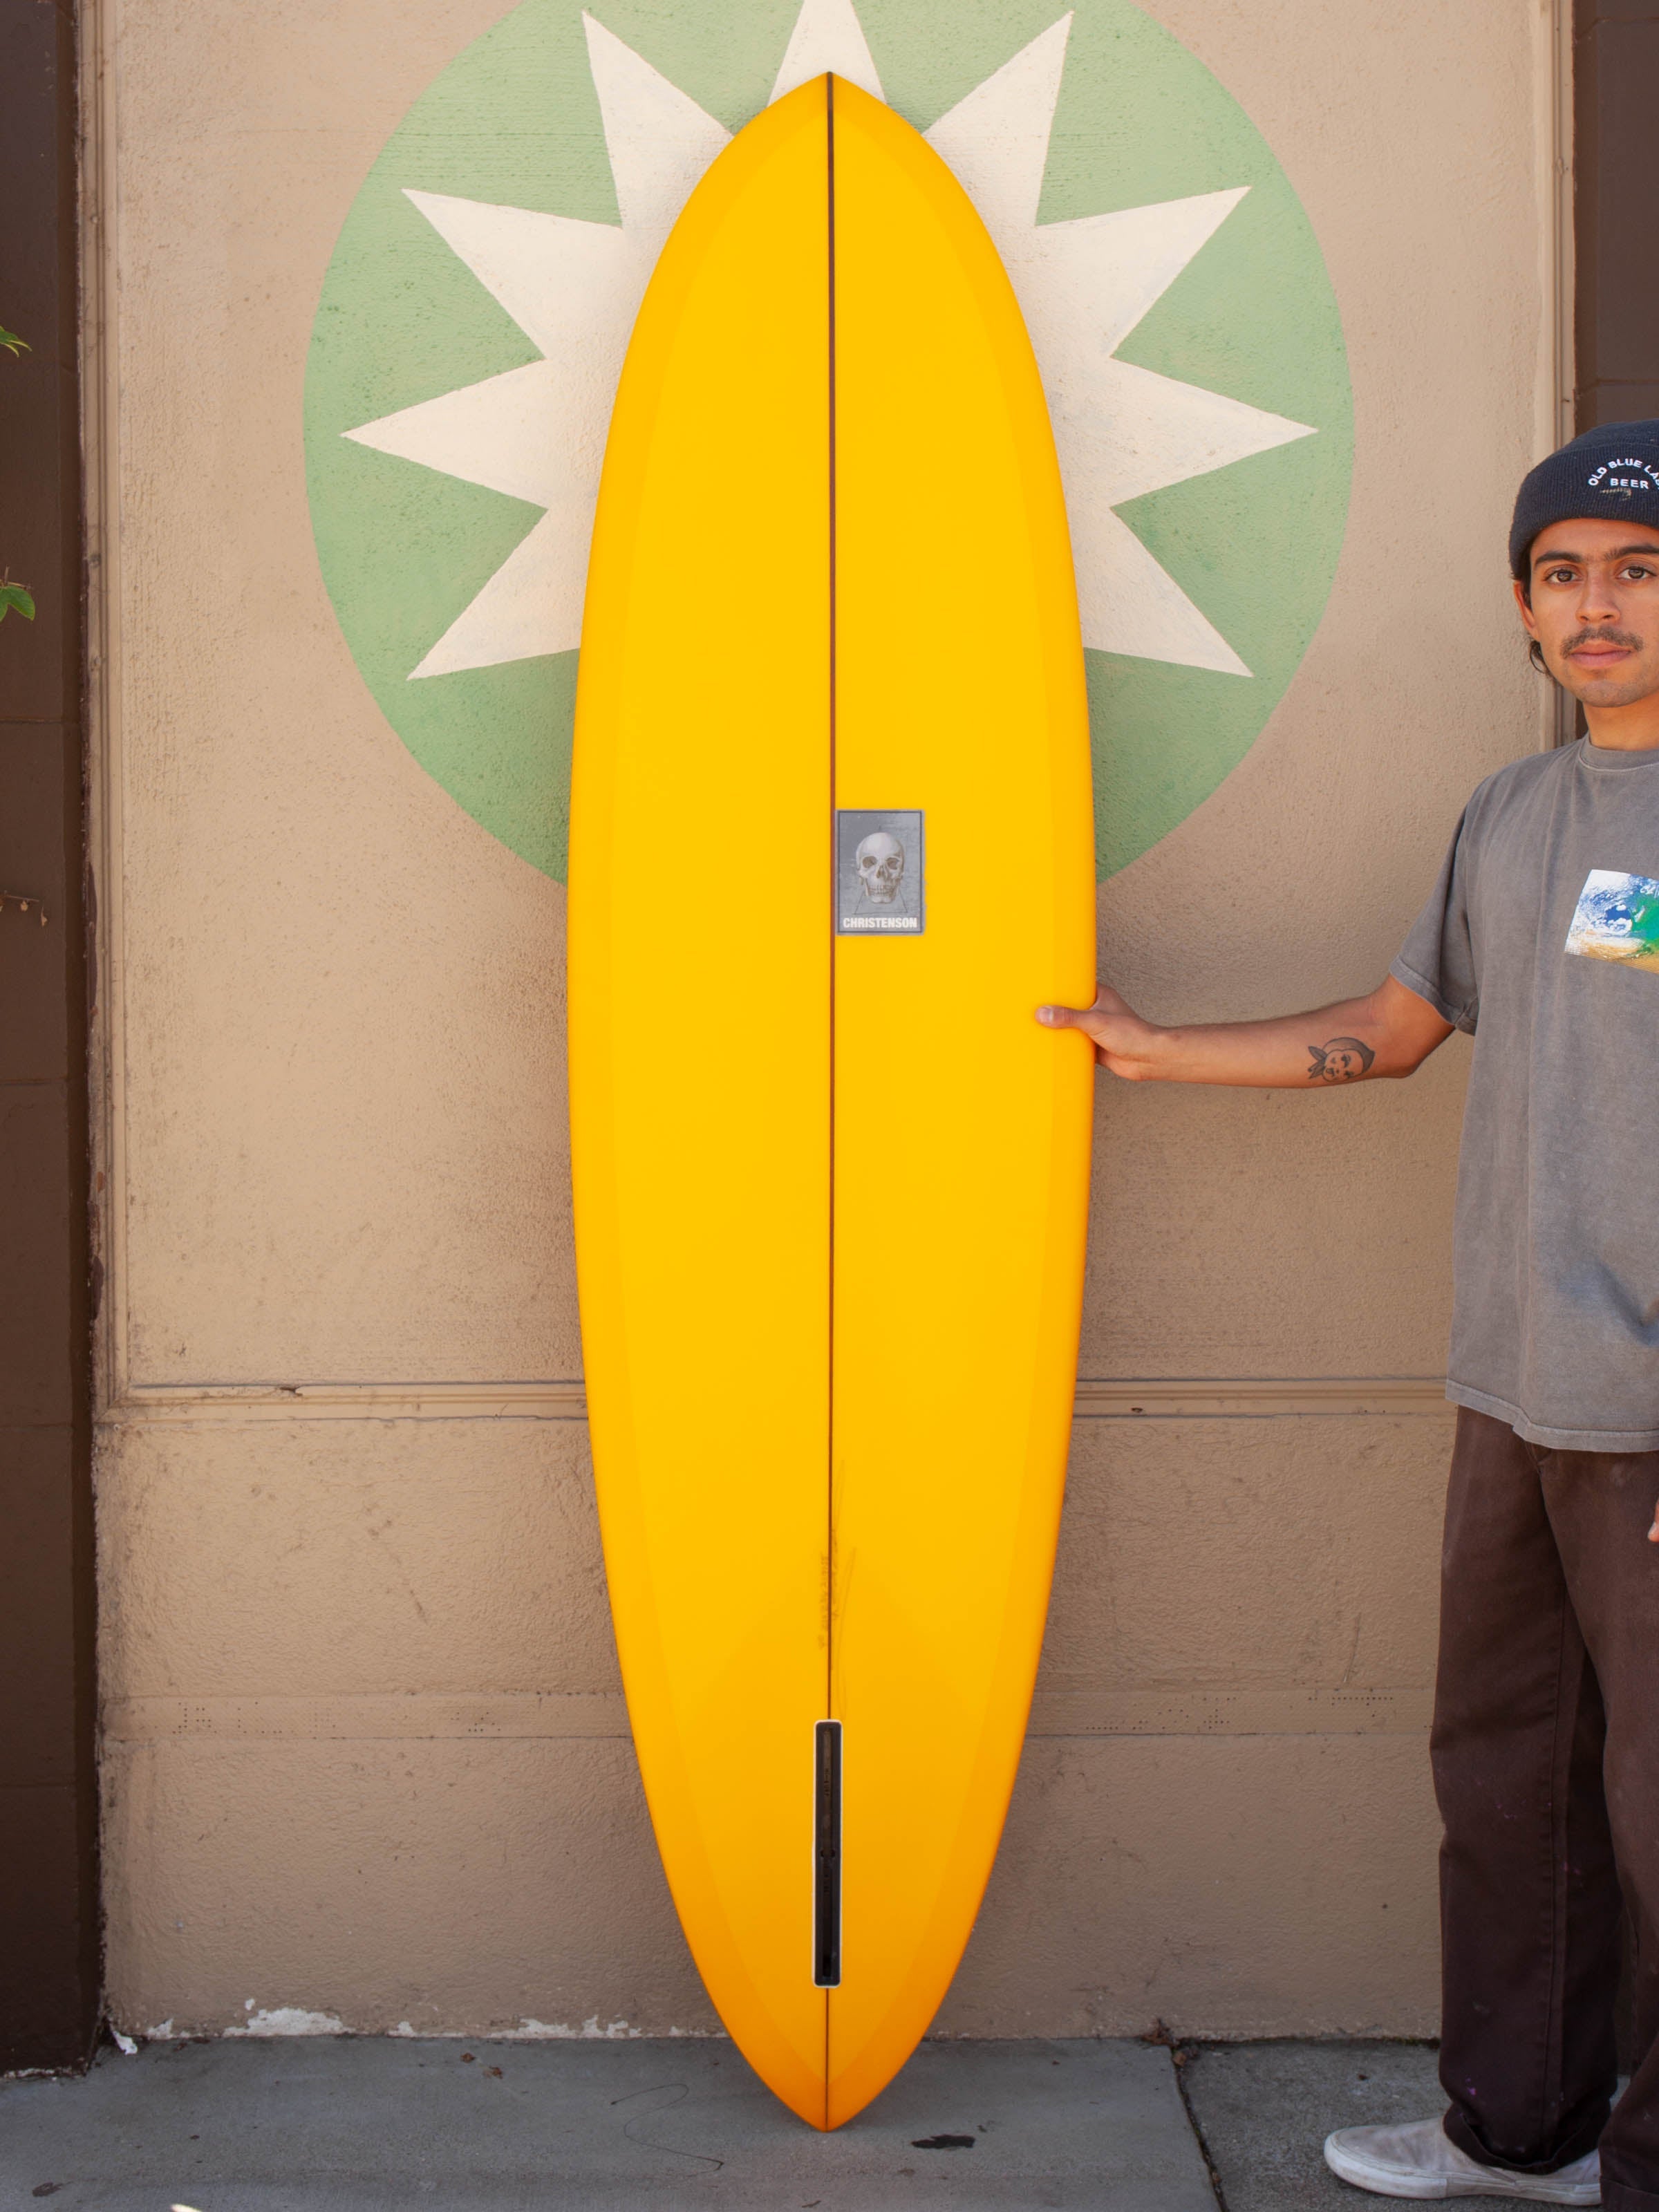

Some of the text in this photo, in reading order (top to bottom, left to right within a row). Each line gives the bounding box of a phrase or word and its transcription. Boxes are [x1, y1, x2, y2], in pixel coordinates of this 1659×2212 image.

[1588, 467, 1607, 486] OLD
[1608, 458, 1643, 469] BLUE
[1610, 478, 1649, 489] BEER
[843, 917, 918, 928] CHRISTENSON
